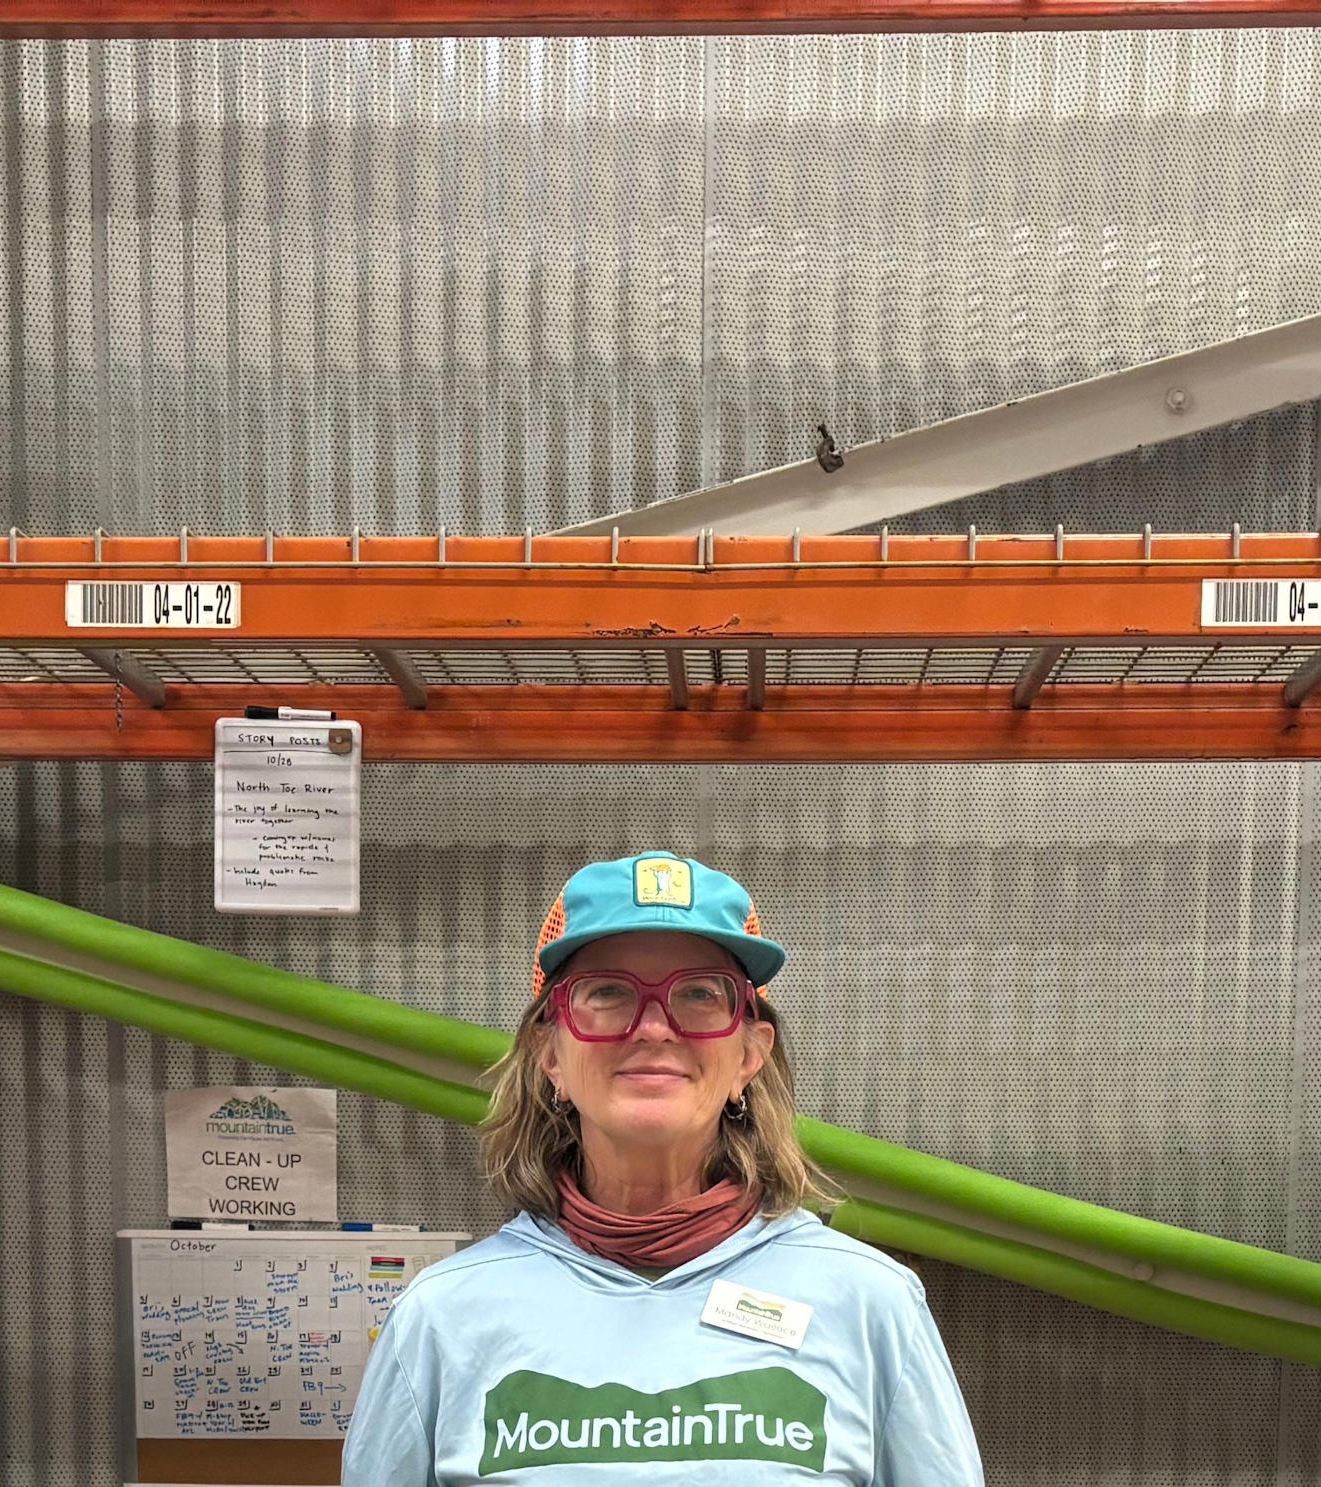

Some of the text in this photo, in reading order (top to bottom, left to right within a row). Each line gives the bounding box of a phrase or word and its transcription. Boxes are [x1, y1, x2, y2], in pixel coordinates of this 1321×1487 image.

[154, 584, 231, 624] 04-01-22
[238, 734, 321, 746] STORY POSTS
[237, 781, 270, 792] North
[305, 784, 334, 794] River
[202, 1151, 261, 1167] CLEAN
[278, 1154, 302, 1168] UP
[225, 1176, 279, 1192] CREW
[209, 1199, 296, 1216] WORKING
[170, 1239, 217, 1252] October
[492, 1403, 814, 1458] MountainTrue
